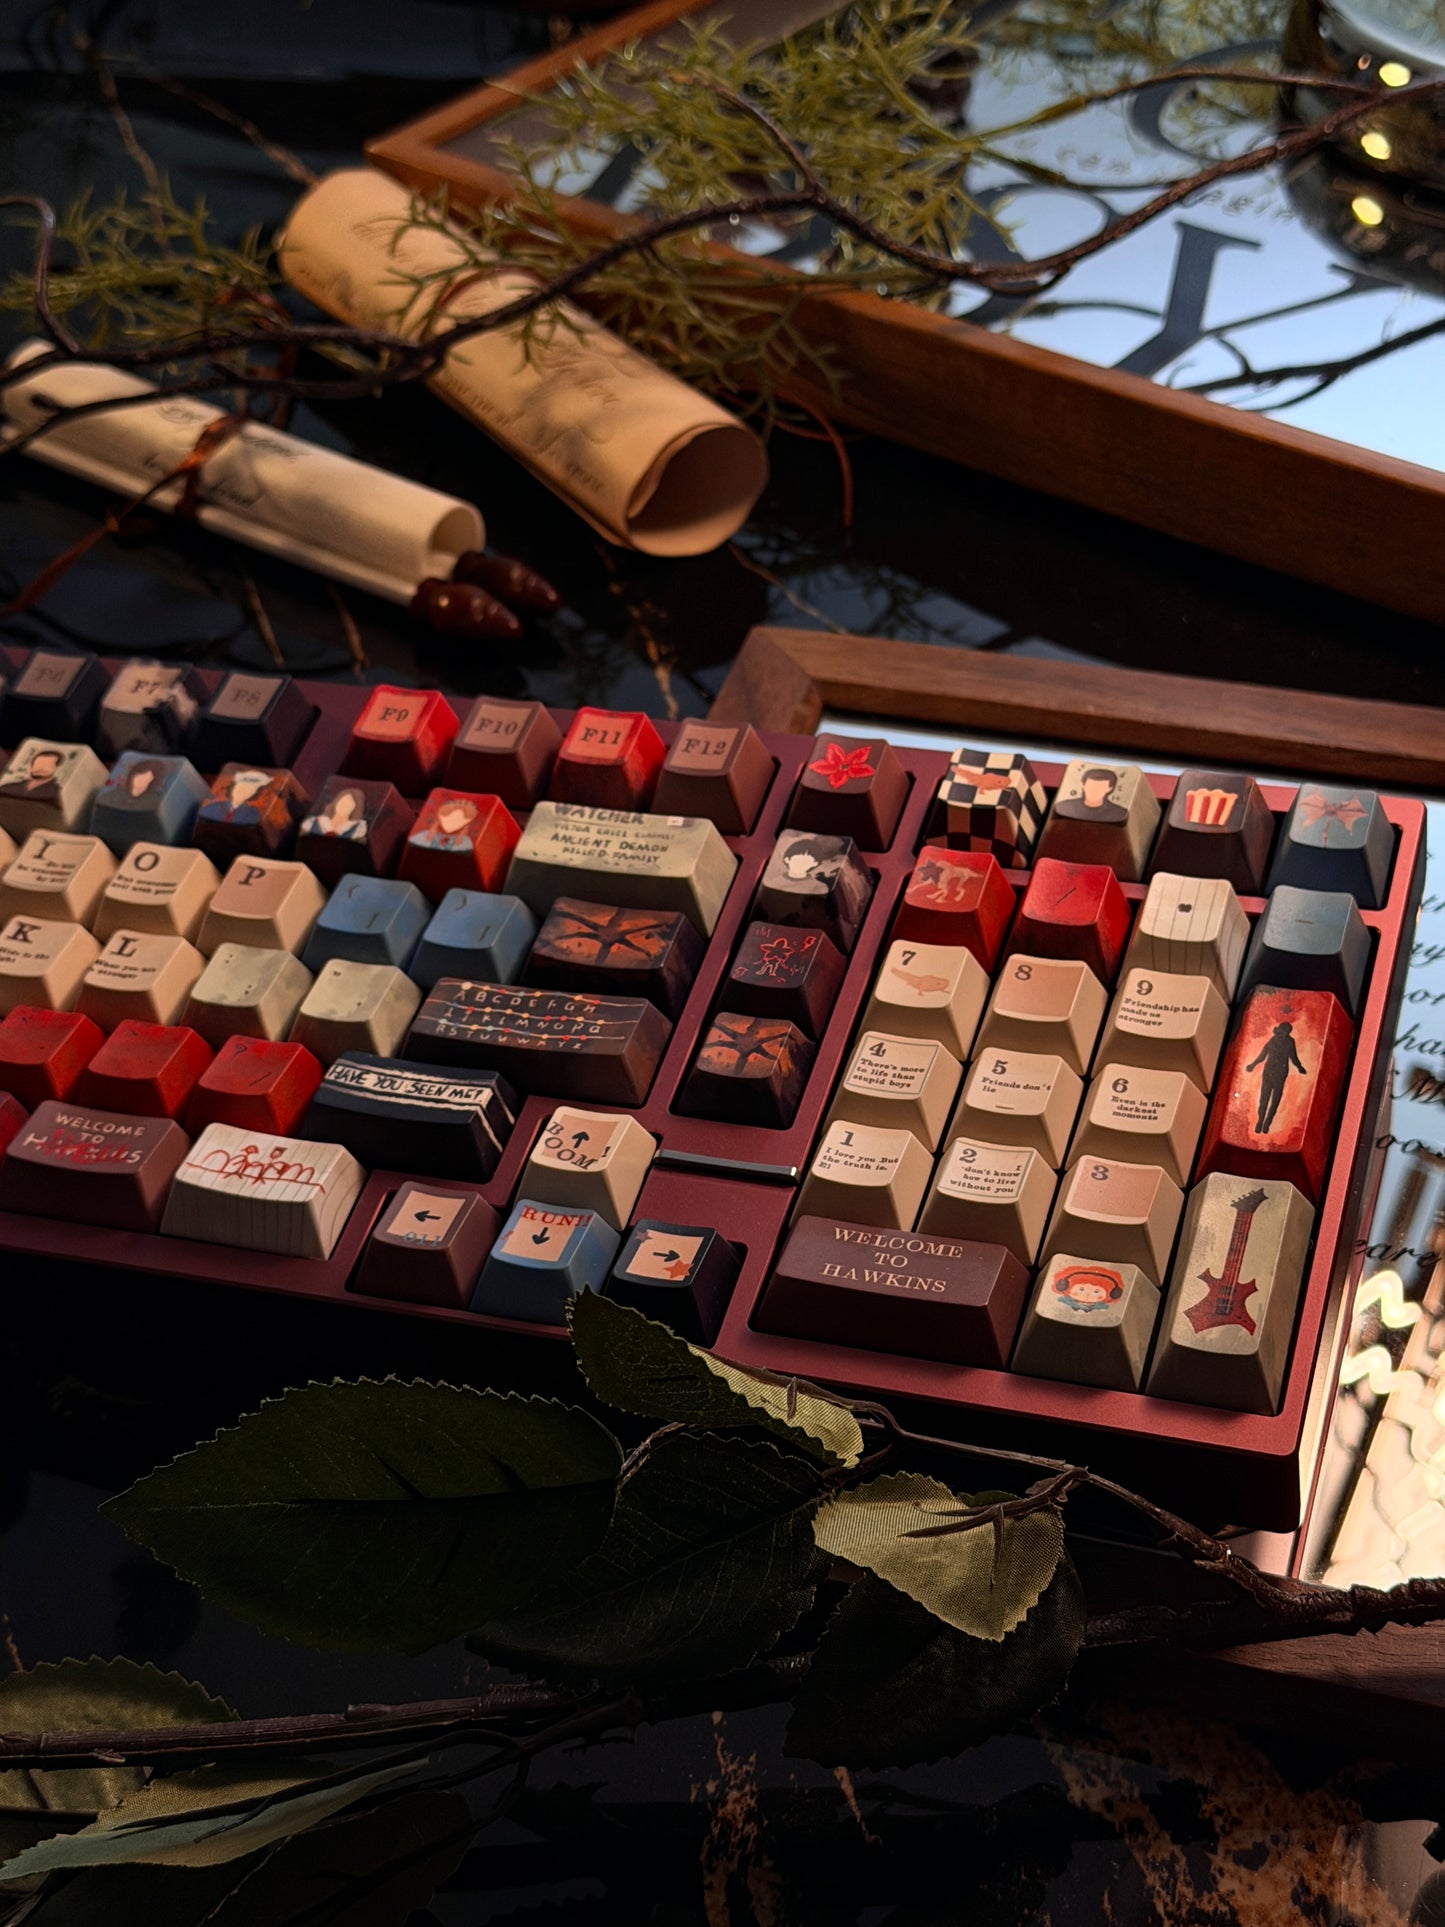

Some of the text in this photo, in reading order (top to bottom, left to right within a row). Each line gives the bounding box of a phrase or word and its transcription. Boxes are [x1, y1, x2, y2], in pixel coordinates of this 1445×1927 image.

[130, 679, 161, 695] F7
[379, 706, 409, 722] F9
[474, 717, 519, 736] F10
[580, 727, 622, 745] F11
[682, 737, 727, 757] F12
[32, 839, 56, 860] I
[551, 833, 669, 853] ANCIENT DEMON
[134, 851, 160, 872] O
[238, 866, 266, 886] P
[7, 921, 42, 944] K
[108, 936, 139, 957] L
[901, 950, 916, 966] 7
[1014, 964, 1033, 981] 8
[1136, 979, 1153, 996] 9
[1120, 1006, 1148, 1018] made
[1123, 997, 1200, 1013] Friendship has
[1118, 1014, 1164, 1027] stronger
[868, 1042, 887, 1058] 4
[860, 1057, 898, 1070] There's
[991, 1059, 1008, 1075] 5
[852, 1073, 911, 1089] stupid boys
[870, 1068, 889, 1077] life
[892, 1072, 915, 1080] than
[328, 1064, 484, 1103] HAVE YOU SEEN ME?
[981, 1076, 1021, 1089] Friends
[982, 1085, 997, 1093] lie
[1111, 1078, 1129, 1094] 6
[1110, 1095, 1166, 1108] Even in the
[1116, 1104, 1157, 1115] darkest
[1112, 1110, 1159, 1121] moments
[55, 1112, 146, 1137] WELCOME
[80, 1132, 105, 1144] TO
[839, 1130, 854, 1147] 1
[822, 1154, 840, 1164] the
[844, 1160, 872, 1170] truth
[834, 1149, 855, 1159] love
[879, 1156, 899, 1164] But
[959, 1148, 977, 1163] 2
[962, 1173, 981, 1181] how
[1091, 1164, 1109, 1180] 3
[950, 1179, 991, 1191] without
[521, 1204, 593, 1228] RUN!!
[834, 1226, 963, 1258] WELCOME
[874, 1252, 909, 1268] TO
[819, 1262, 947, 1293] HAWKINS
